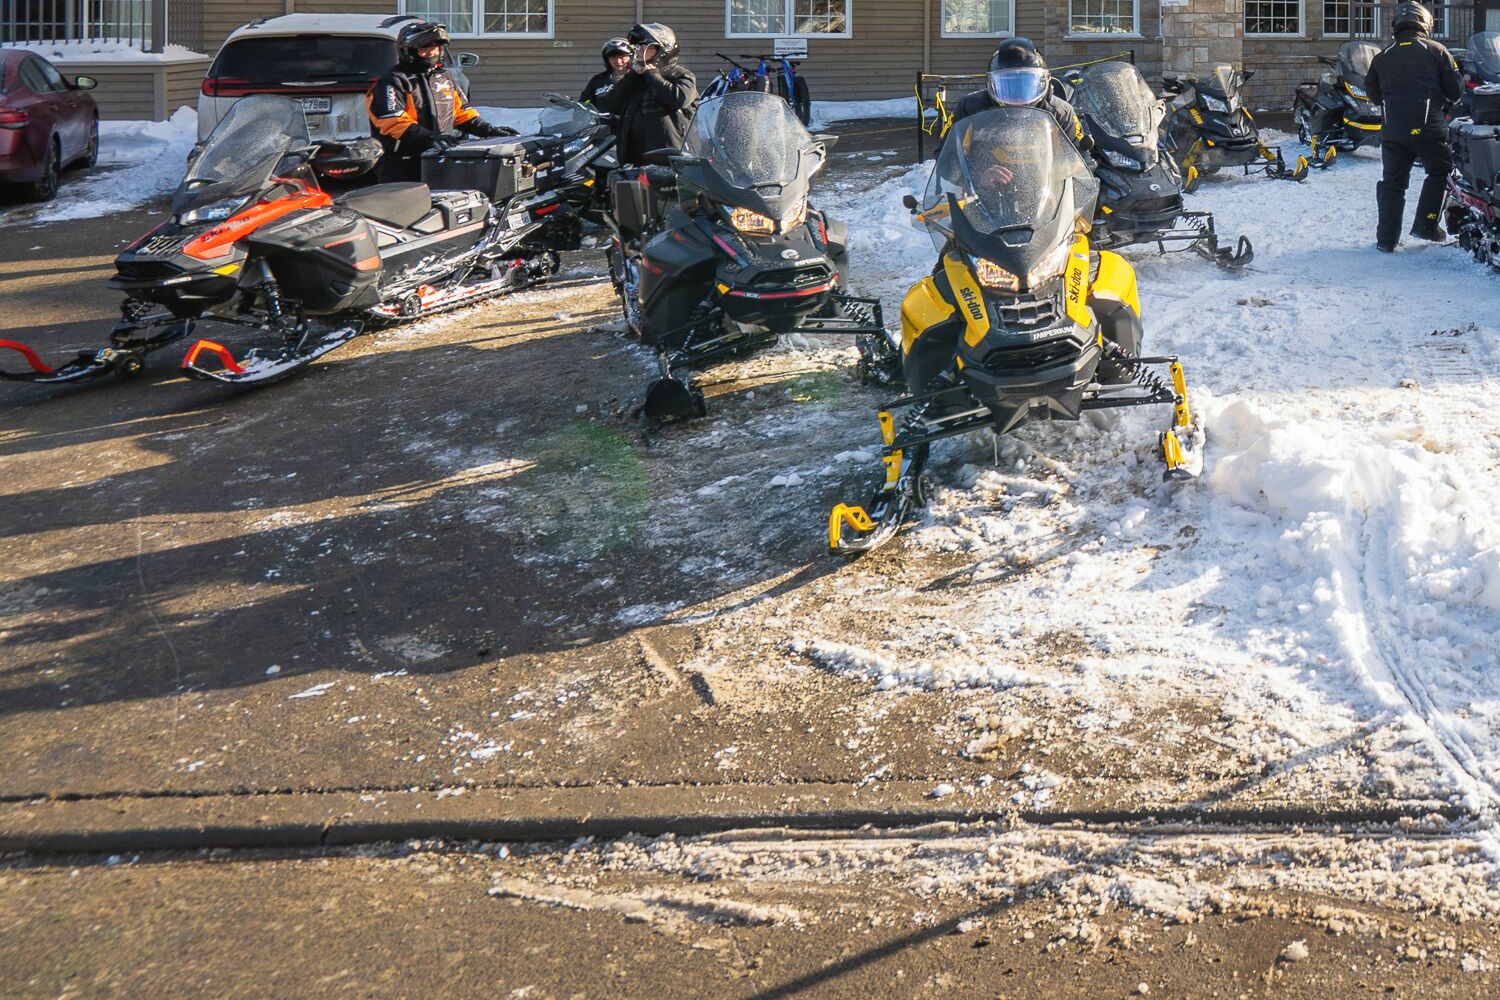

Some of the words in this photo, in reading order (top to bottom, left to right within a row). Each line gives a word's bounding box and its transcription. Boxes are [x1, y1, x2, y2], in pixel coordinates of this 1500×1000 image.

[1069, 267, 1082, 304] ski-doo
[960, 287, 983, 321] ski-doo
[1033, 326, 1074, 341] IMPERIUM
